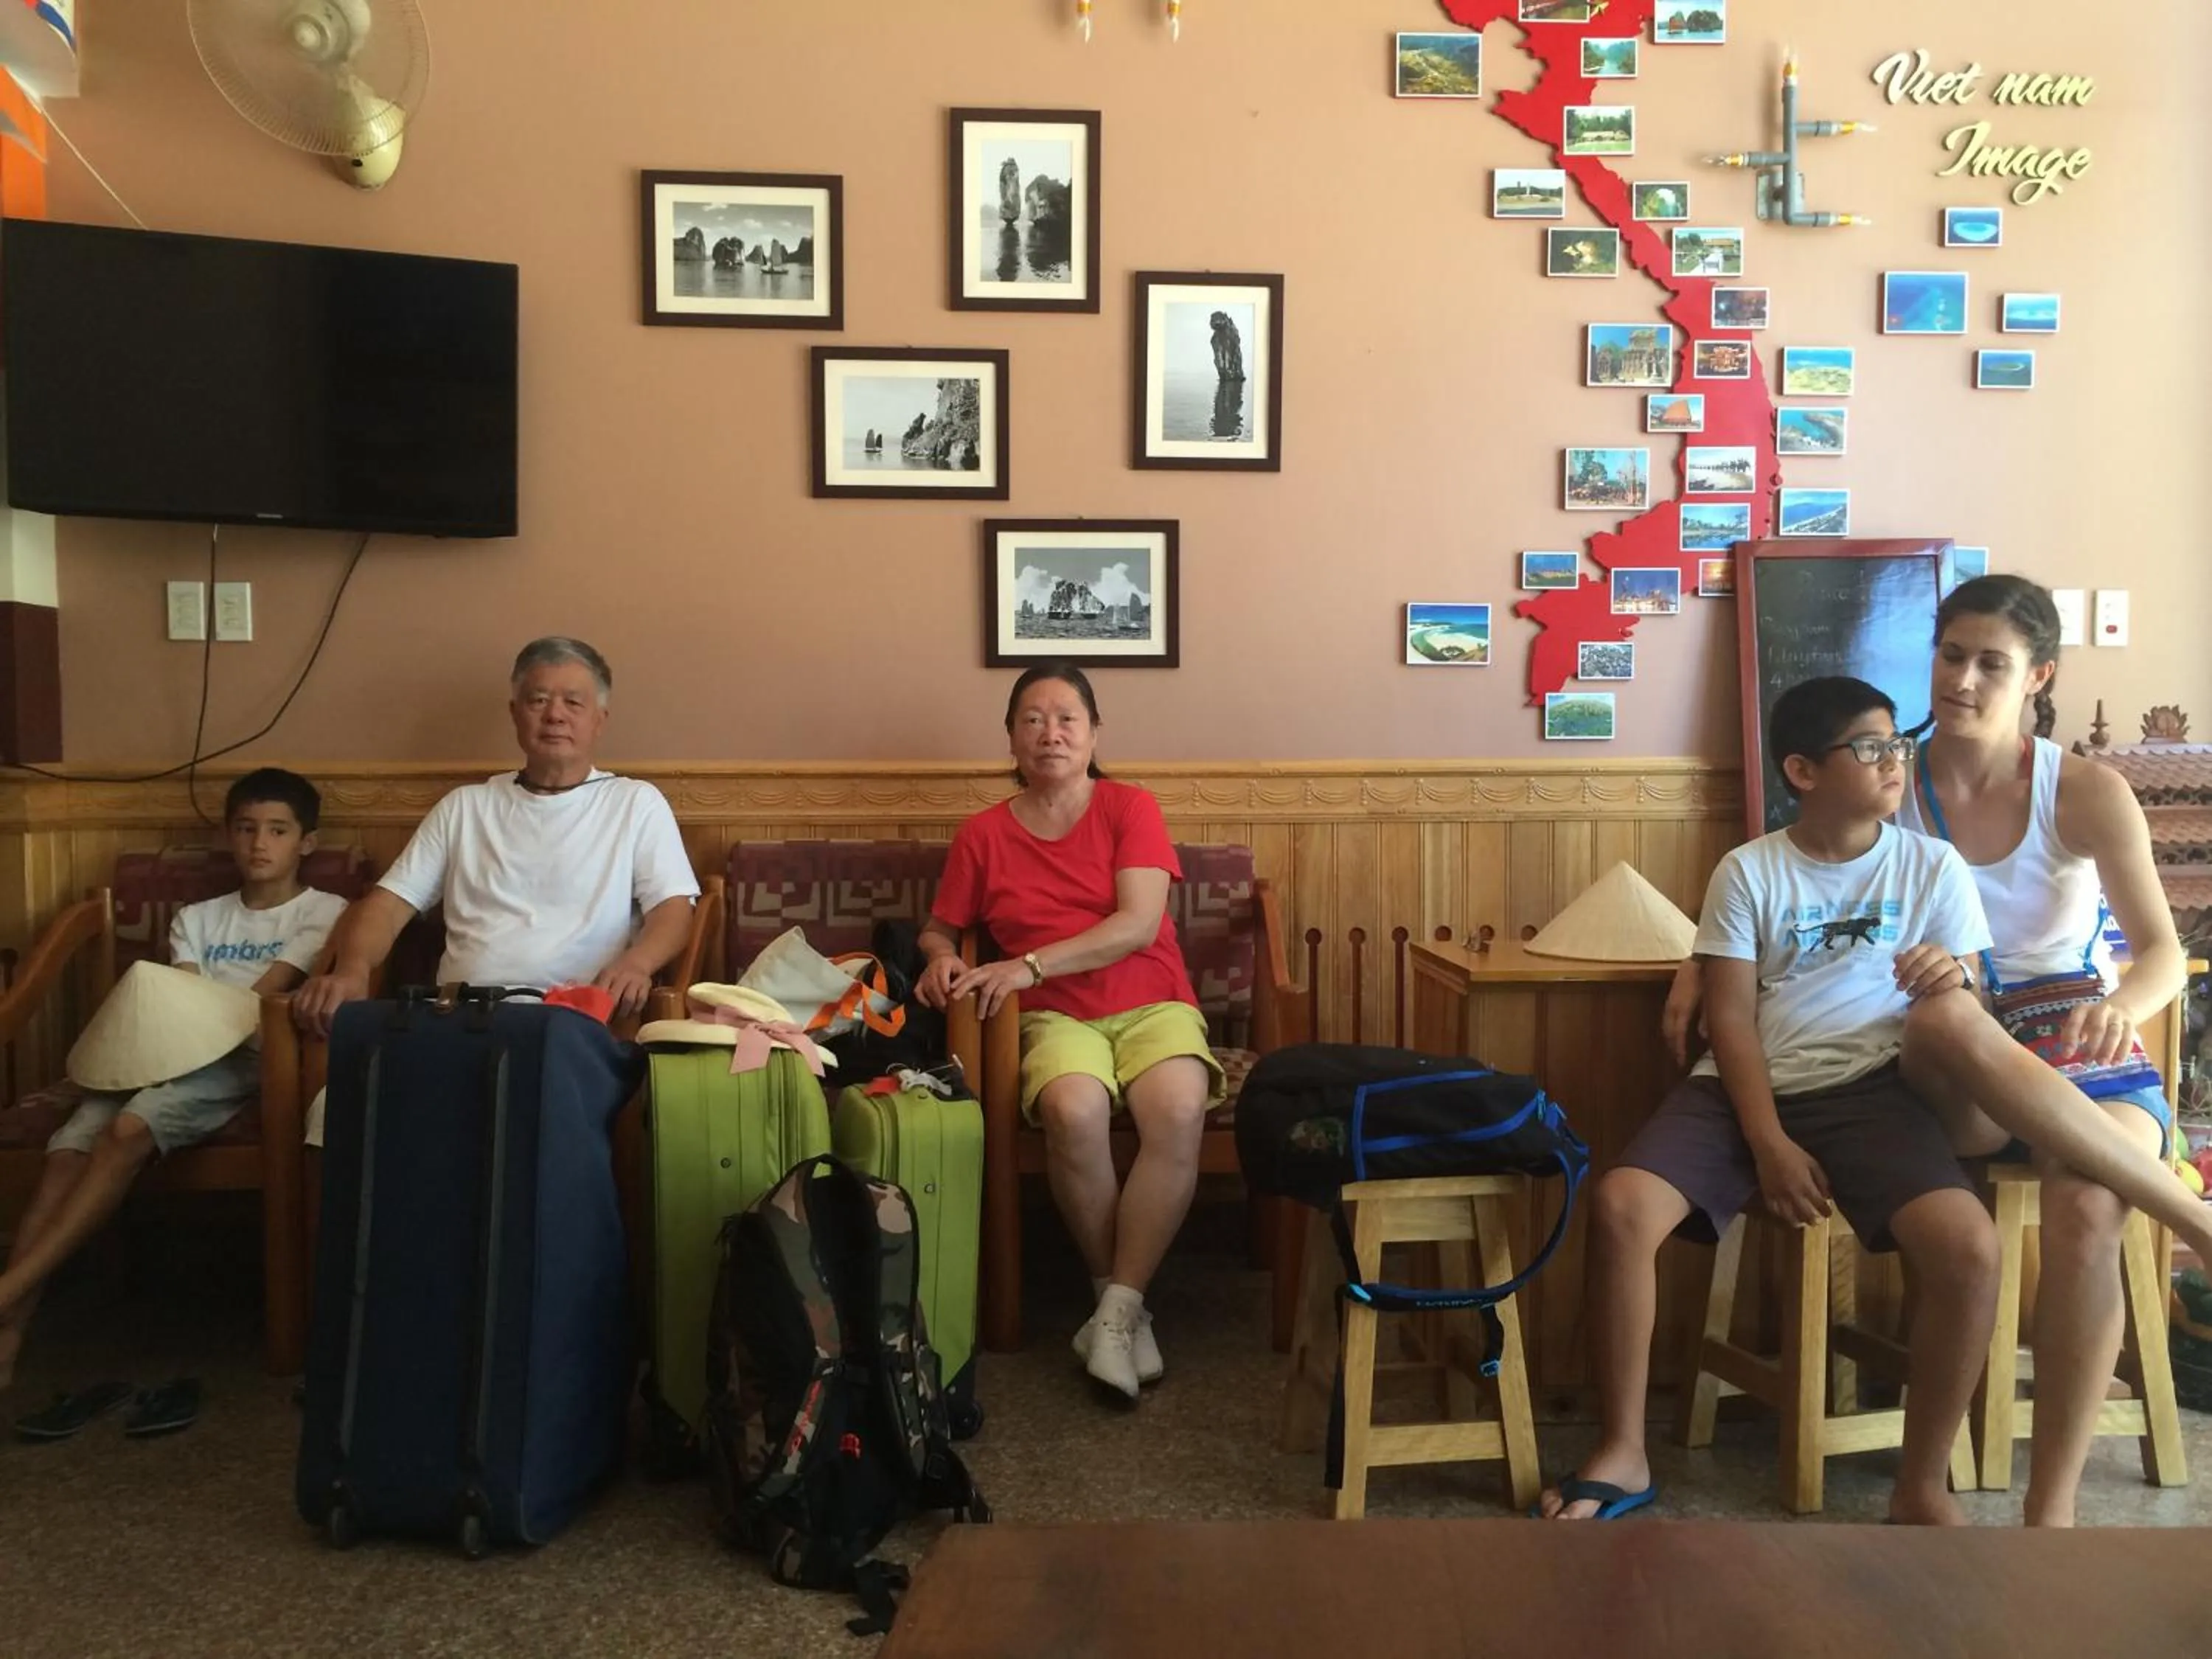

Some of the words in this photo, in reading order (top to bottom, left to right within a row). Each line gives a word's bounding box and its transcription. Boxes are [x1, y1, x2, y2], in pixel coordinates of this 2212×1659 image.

[1871, 48, 1983, 105] Viet
[1992, 72, 2096, 105] nam
[1935, 121, 2092, 206] Image
